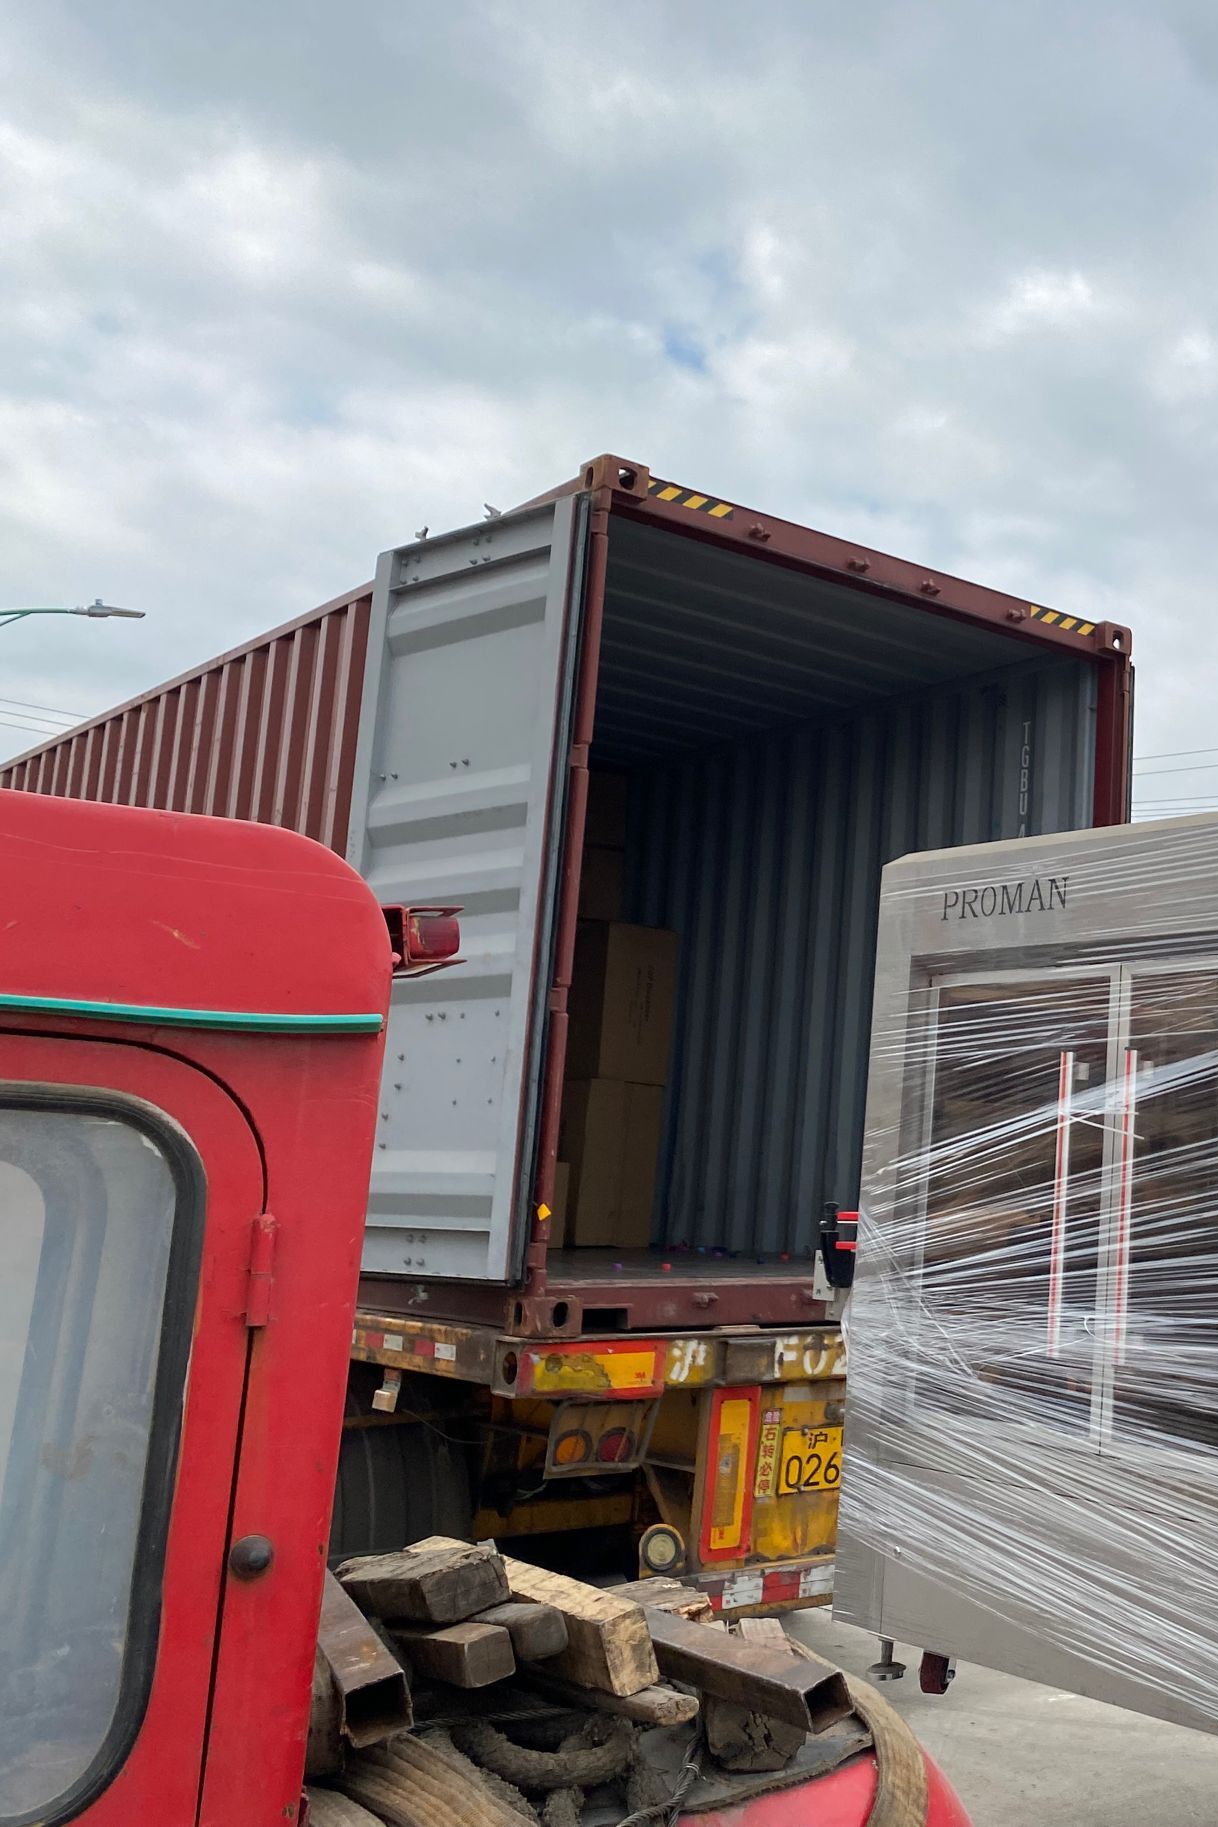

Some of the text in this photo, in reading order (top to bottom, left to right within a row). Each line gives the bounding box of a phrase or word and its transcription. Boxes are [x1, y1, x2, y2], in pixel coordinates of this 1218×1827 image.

[1019, 721, 1031, 815] TGBU
[941, 876, 1070, 921] PROMAN
[807, 1431, 828, 1450] 沪
[785, 1451, 840, 1489] 026
